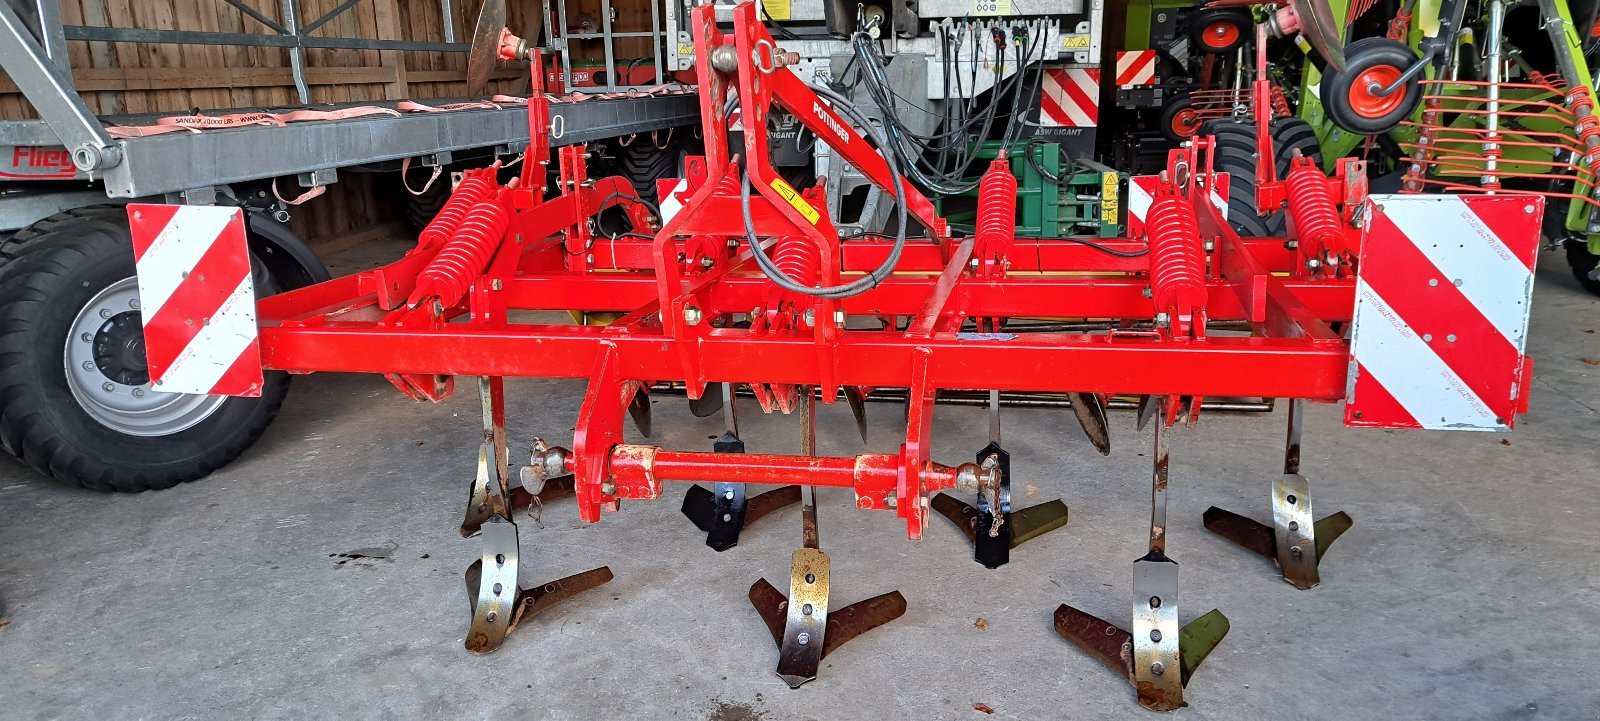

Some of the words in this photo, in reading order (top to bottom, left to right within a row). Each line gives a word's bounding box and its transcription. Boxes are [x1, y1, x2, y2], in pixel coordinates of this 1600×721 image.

[771, 131, 796, 139] IGANT
[1034, 128, 1052, 136] ASW
[1053, 128, 1082, 136] GIGANT
[12, 145, 77, 173] Flieg
